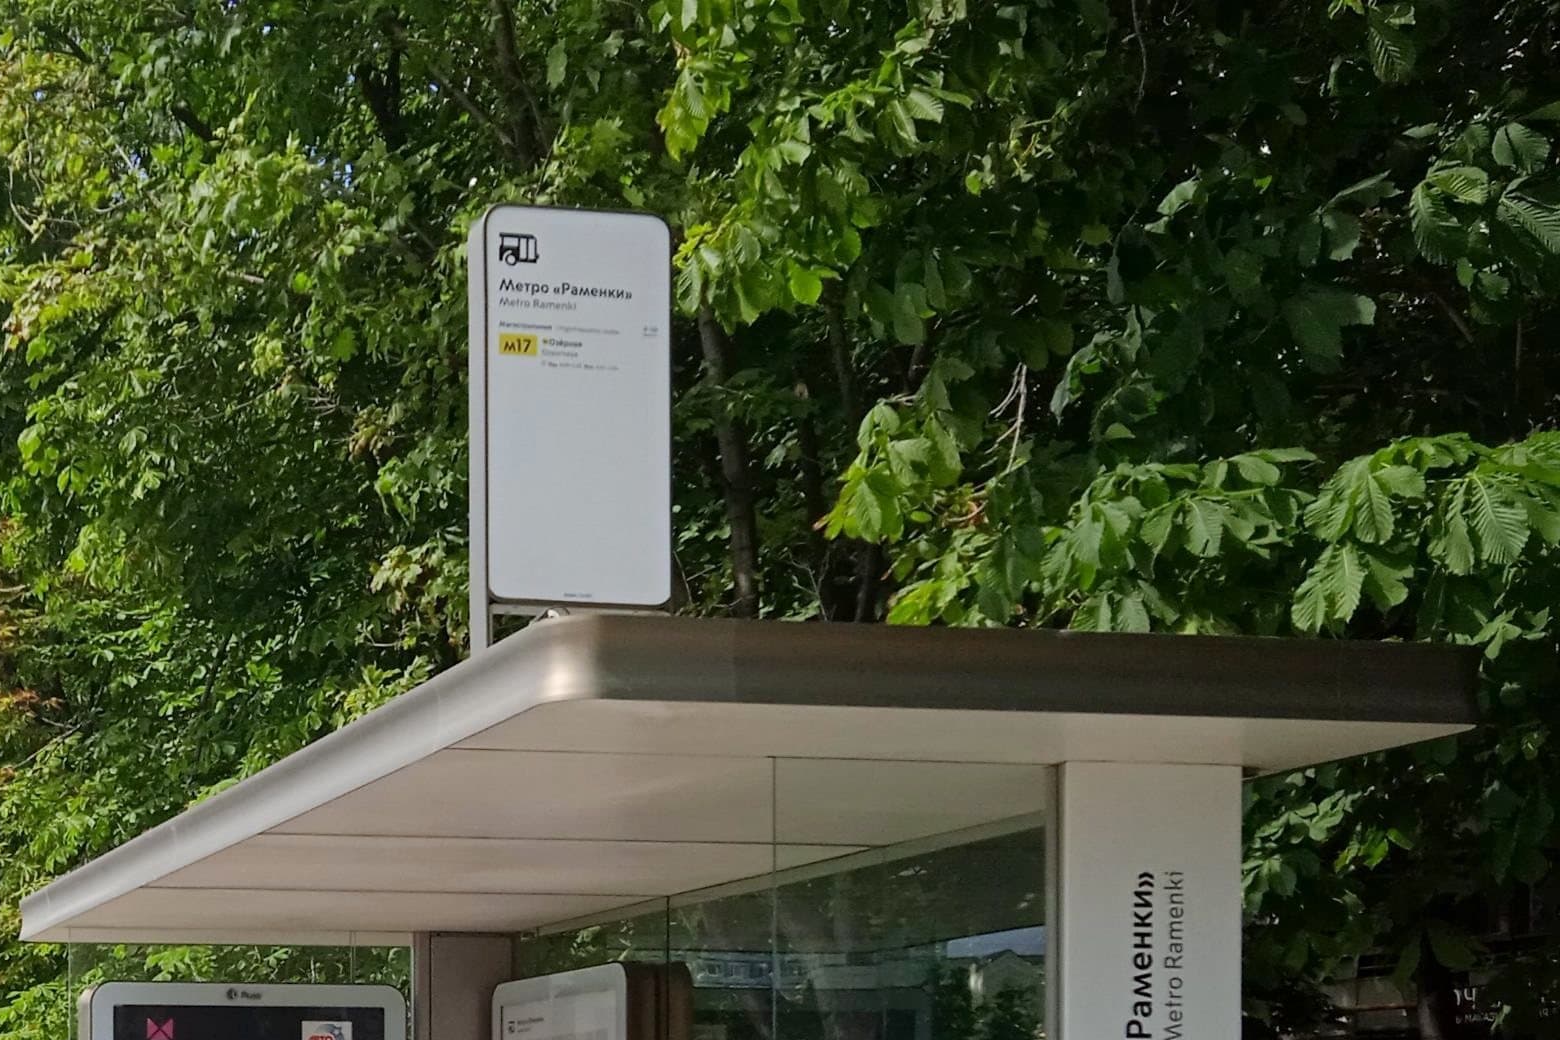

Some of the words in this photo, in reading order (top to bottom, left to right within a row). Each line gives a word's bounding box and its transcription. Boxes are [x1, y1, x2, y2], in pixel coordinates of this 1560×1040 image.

[499, 278, 550, 296] Метро
[553, 282, 633, 300] «Раменки»
[499, 297, 530, 308] Metro
[533, 300, 577, 311] Ramenki
[1163, 871, 1184, 969] Ramenki
